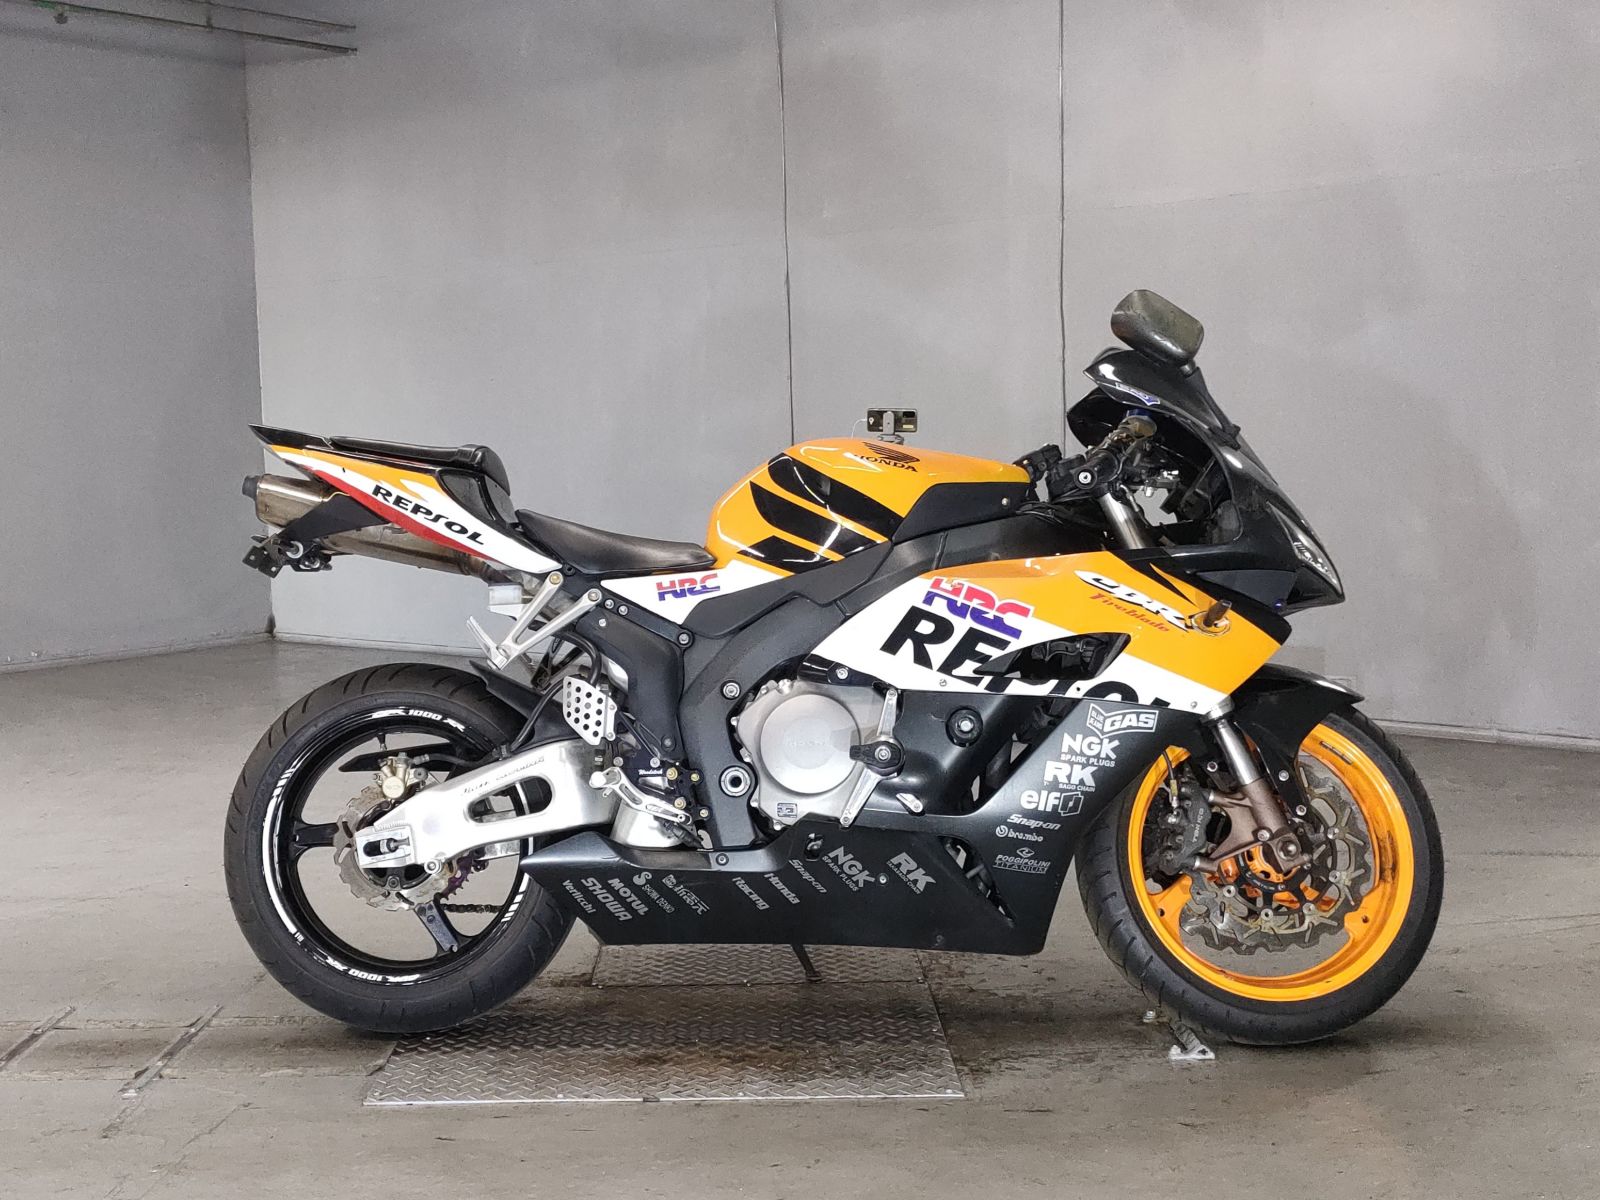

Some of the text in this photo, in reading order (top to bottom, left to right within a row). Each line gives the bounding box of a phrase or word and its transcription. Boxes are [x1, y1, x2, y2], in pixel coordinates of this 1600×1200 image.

[371, 484, 484, 545] REPSOL
[656, 573, 720, 602] HRC
[1073, 569, 1190, 633] CBR
[921, 577, 1033, 640] HRC
[1088, 592, 1169, 632] Fireblade
[408, 708, 443, 721] 1000
[1102, 713, 1156, 733] GAS
[1060, 753, 1116, 768] SPARK PLUGS
[1061, 732, 1120, 760] NGK
[1043, 760, 1098, 787] RK
[1020, 788, 1060, 812] elf
[1006, 813, 1061, 830] Snap-on
[1007, 828, 1044, 842] brembo
[821, 855, 860, 892] SPARK PLUGS
[827, 846, 876, 888] NGK
[890, 852, 937, 892] RK
[996, 854, 1051, 868] POGGIPOLINI
[562, 879, 597, 914] Verlicchi
[581, 877, 633, 921] SHOWA
[607, 878, 649, 916] MOTUL
[731, 876, 770, 911] Racing
[764, 872, 800, 905] Honda
[347, 968, 382, 982] 1000
